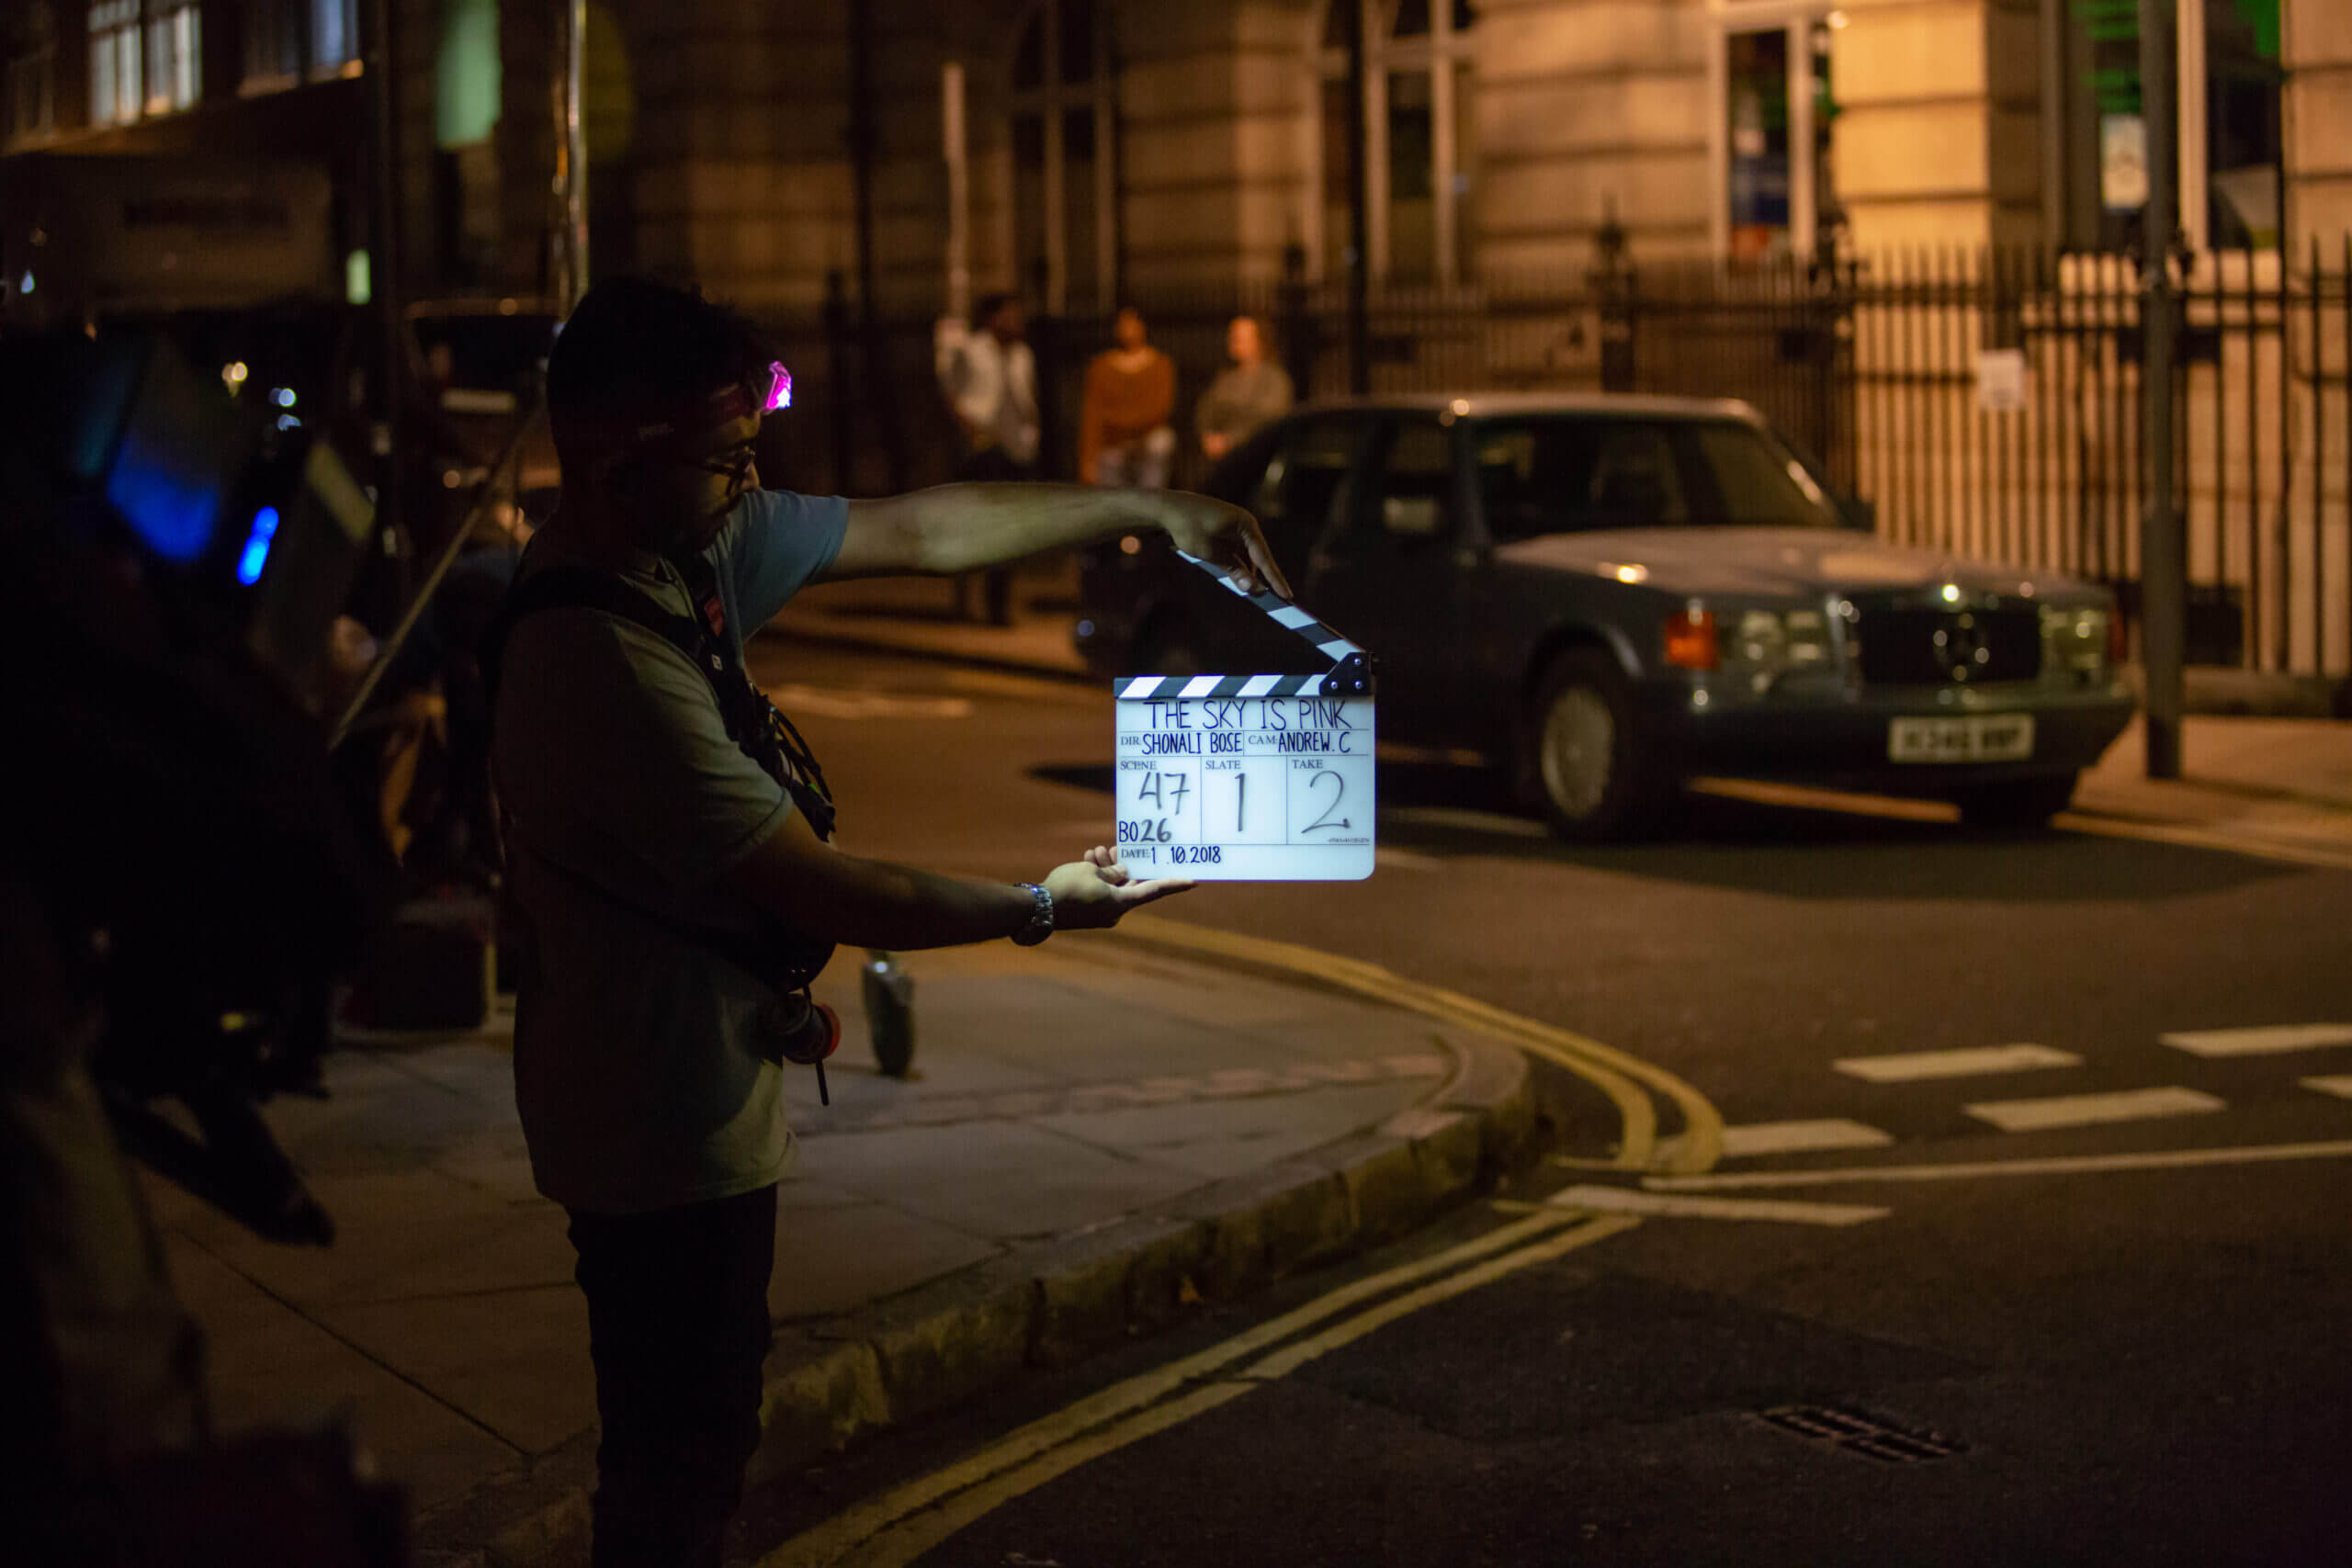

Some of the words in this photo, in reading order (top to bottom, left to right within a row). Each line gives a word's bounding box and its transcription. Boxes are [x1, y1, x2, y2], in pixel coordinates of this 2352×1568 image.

[1142, 700, 1192, 729] THE
[1202, 699, 1247, 729] SKY
[1260, 699, 1286, 731] IS
[1299, 698, 1352, 729] PINK
[1141, 732, 1202, 755] SHONALI
[1210, 732, 1243, 753] BOSE
[1120, 760, 1158, 771] SCENE
[1204, 760, 1241, 770] SLATE
[1292, 759, 1324, 770] TAKE
[1138, 772, 1191, 816] 47
[1234, 773, 1246, 832] 1
[1301, 770, 1351, 834] 2
